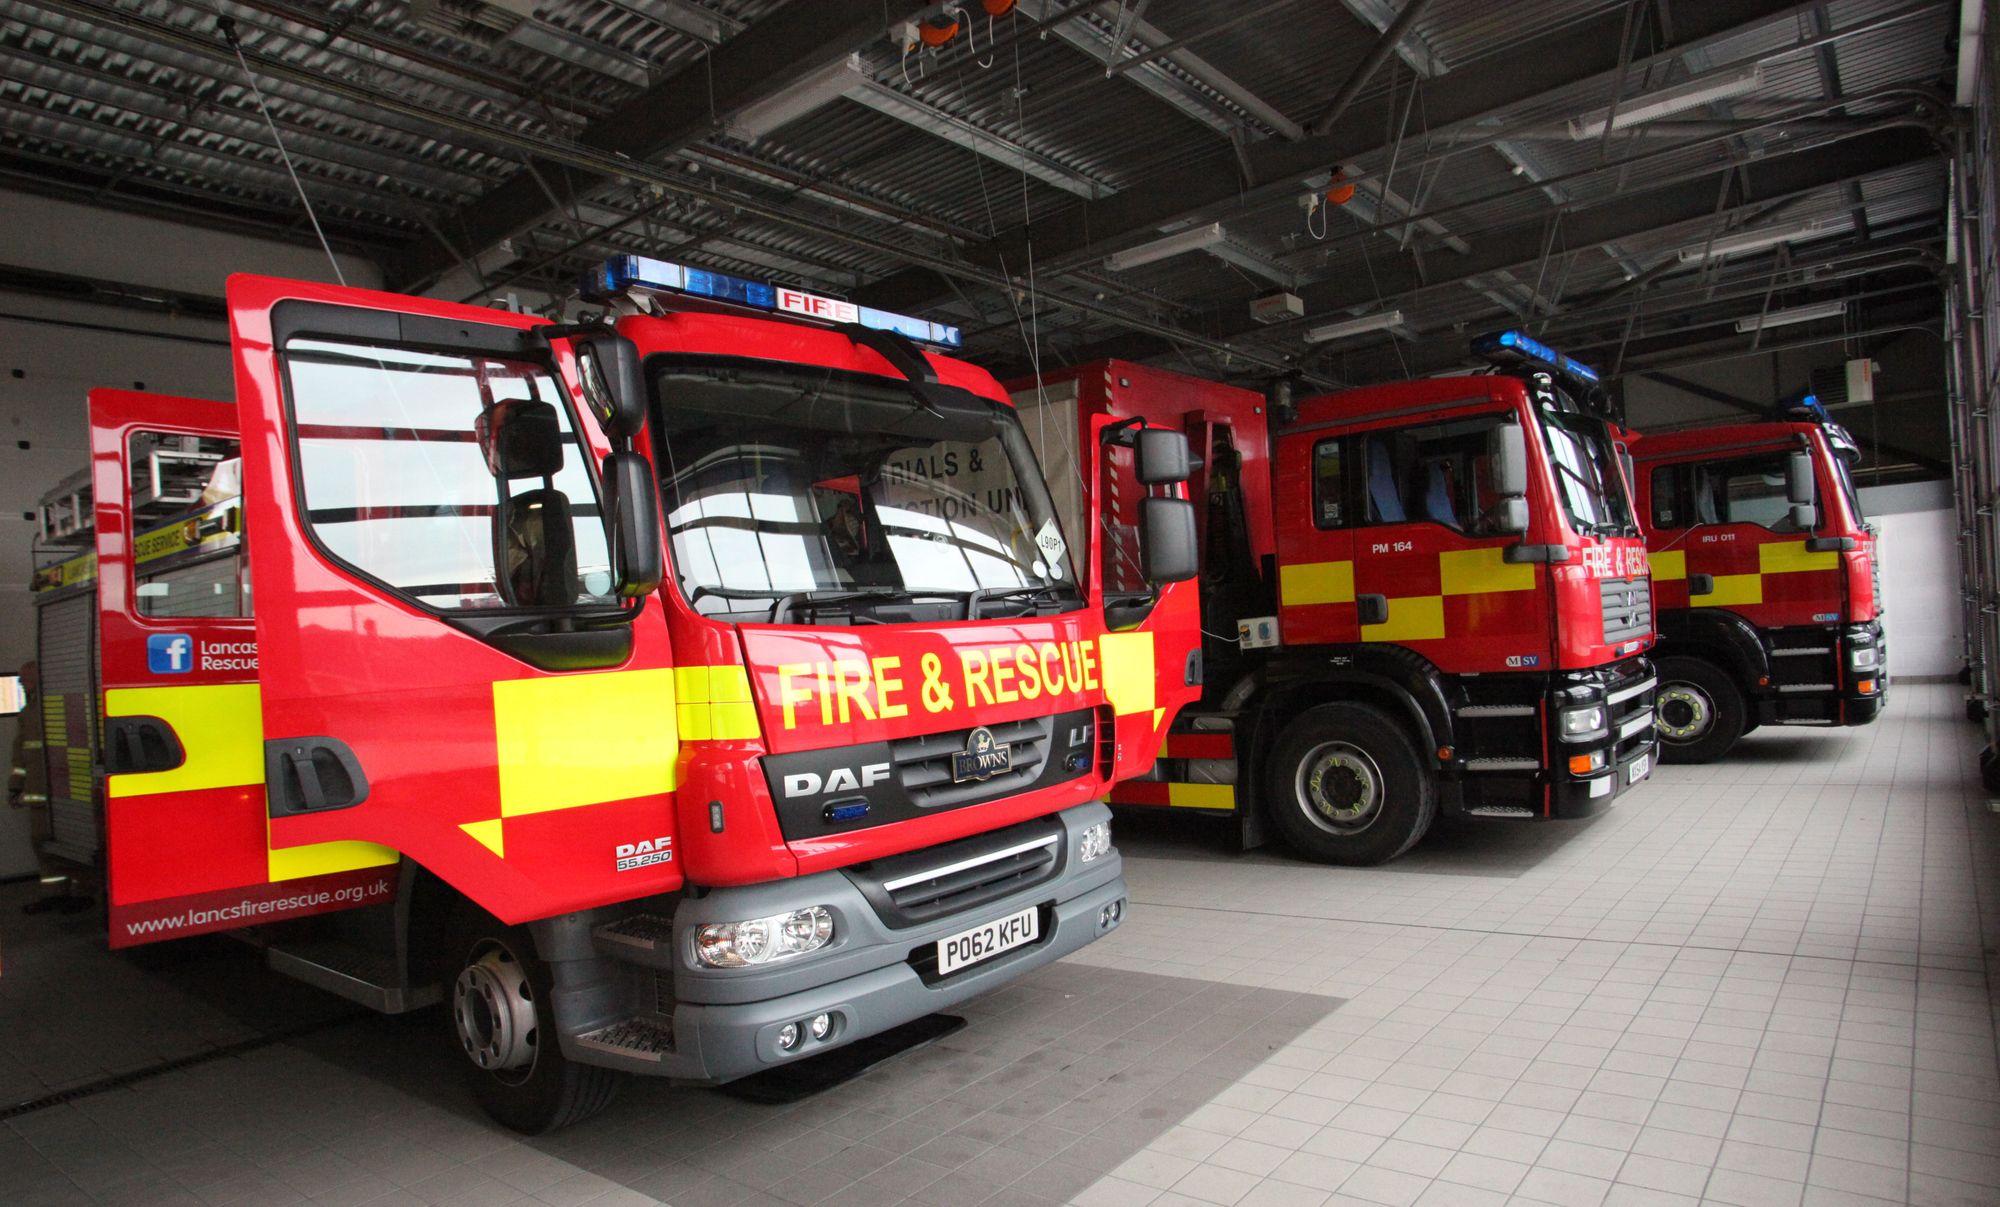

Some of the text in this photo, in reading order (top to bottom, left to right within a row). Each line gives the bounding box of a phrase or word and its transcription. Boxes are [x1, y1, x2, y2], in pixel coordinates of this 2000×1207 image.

[783, 292, 853, 321] FIRE
[969, 448, 984, 473] &
[1372, 541, 1413, 554] PM 164
[1582, 547, 1613, 577] FIRE
[778, 640, 1099, 730] FIRE & RESCUE
[959, 750, 1008, 773] BROWNS
[784, 762, 890, 799] DAF
[616, 836, 672, 858] DAF
[617, 851, 672, 870] 55.250
[127, 879, 389, 936] www.lancsfirerescue.org.uk
[999, 913, 1032, 948] KFU
